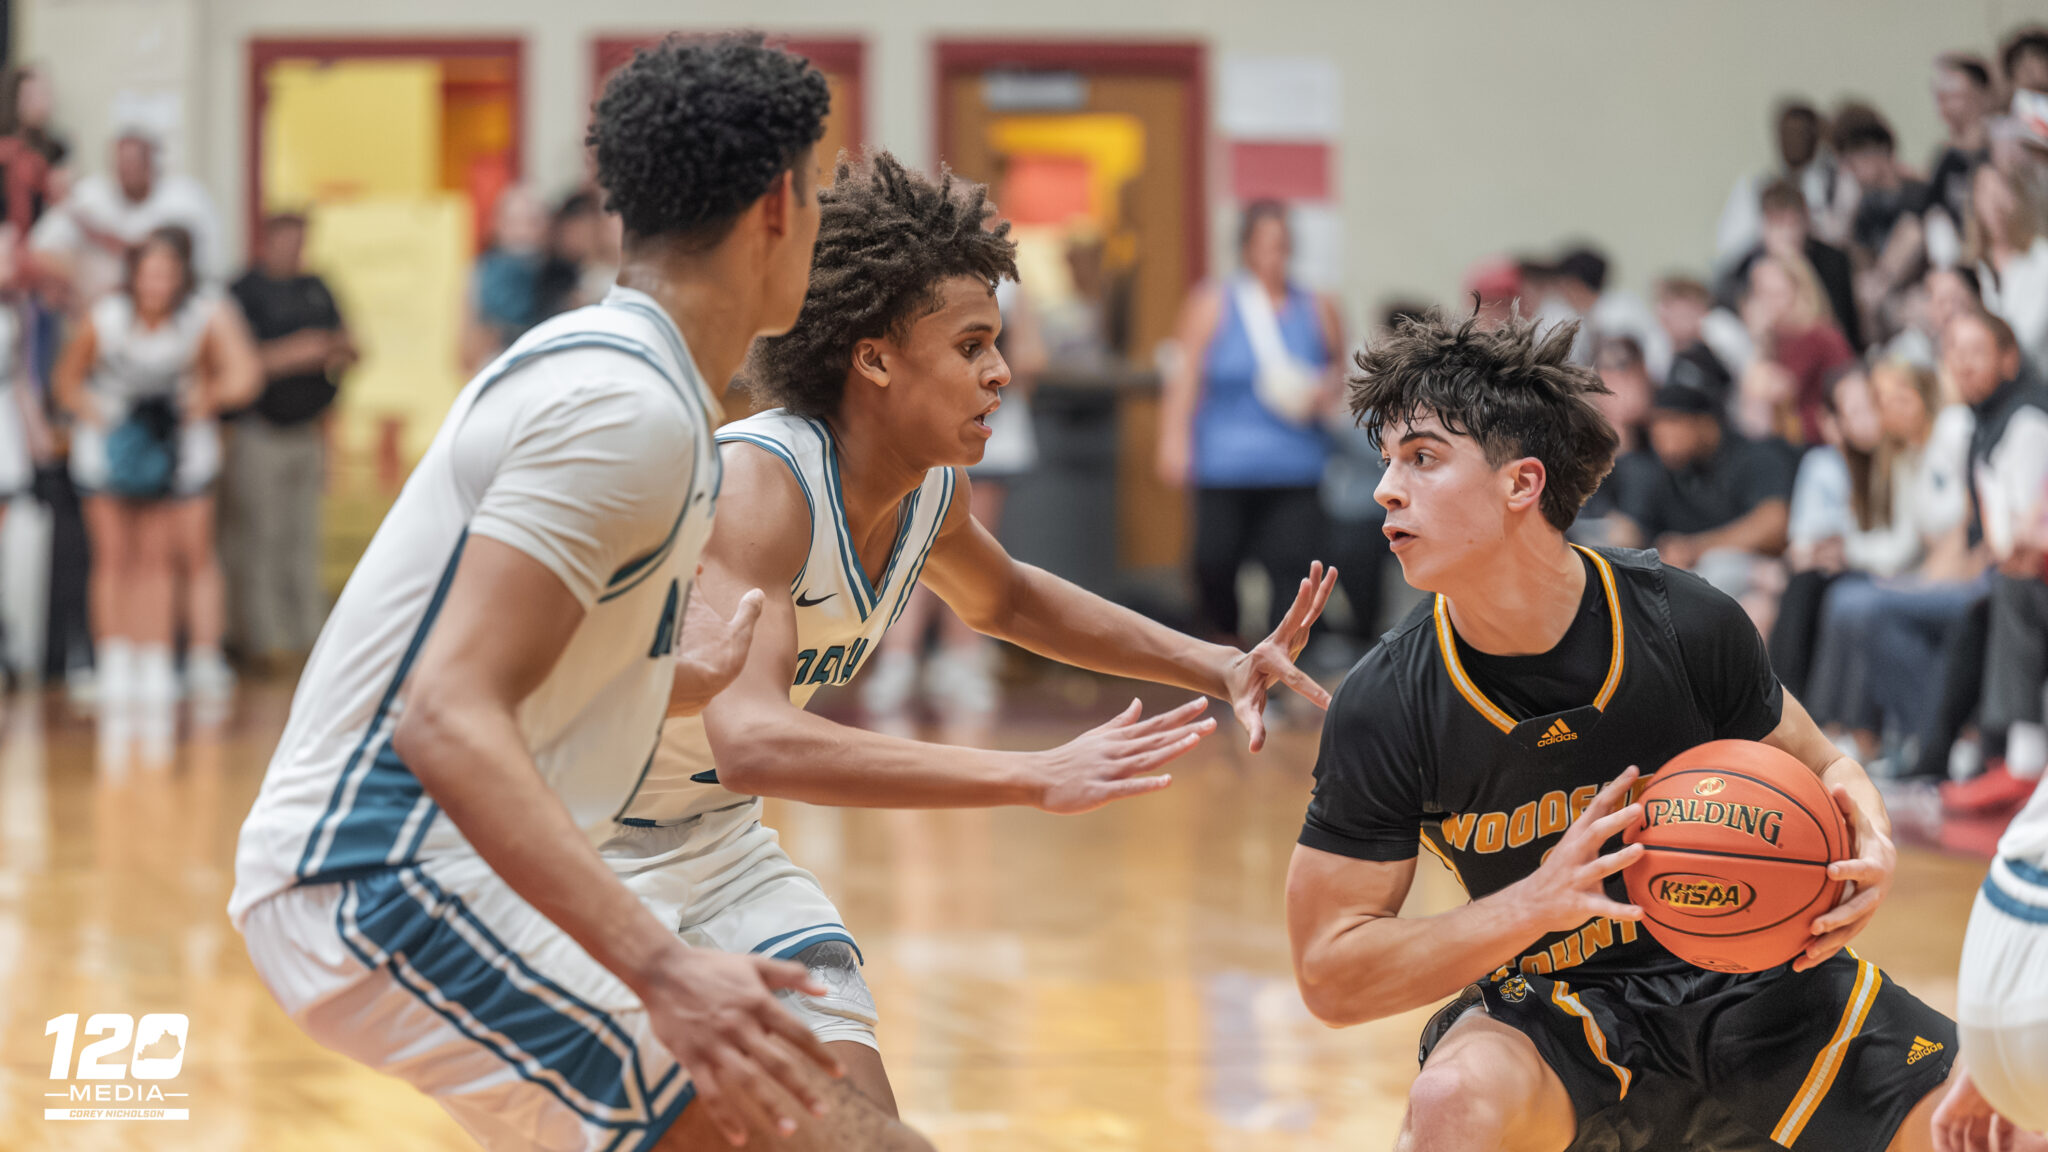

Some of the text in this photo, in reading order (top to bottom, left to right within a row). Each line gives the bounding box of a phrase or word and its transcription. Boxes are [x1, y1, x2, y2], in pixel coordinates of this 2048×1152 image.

[1537, 732, 1578, 748] adidas
[1640, 798, 1784, 848] SPALDING
[1659, 879, 1741, 908] KHSAA
[1490, 917, 1638, 982] OUNT
[1906, 1041, 1944, 1065] adidas
